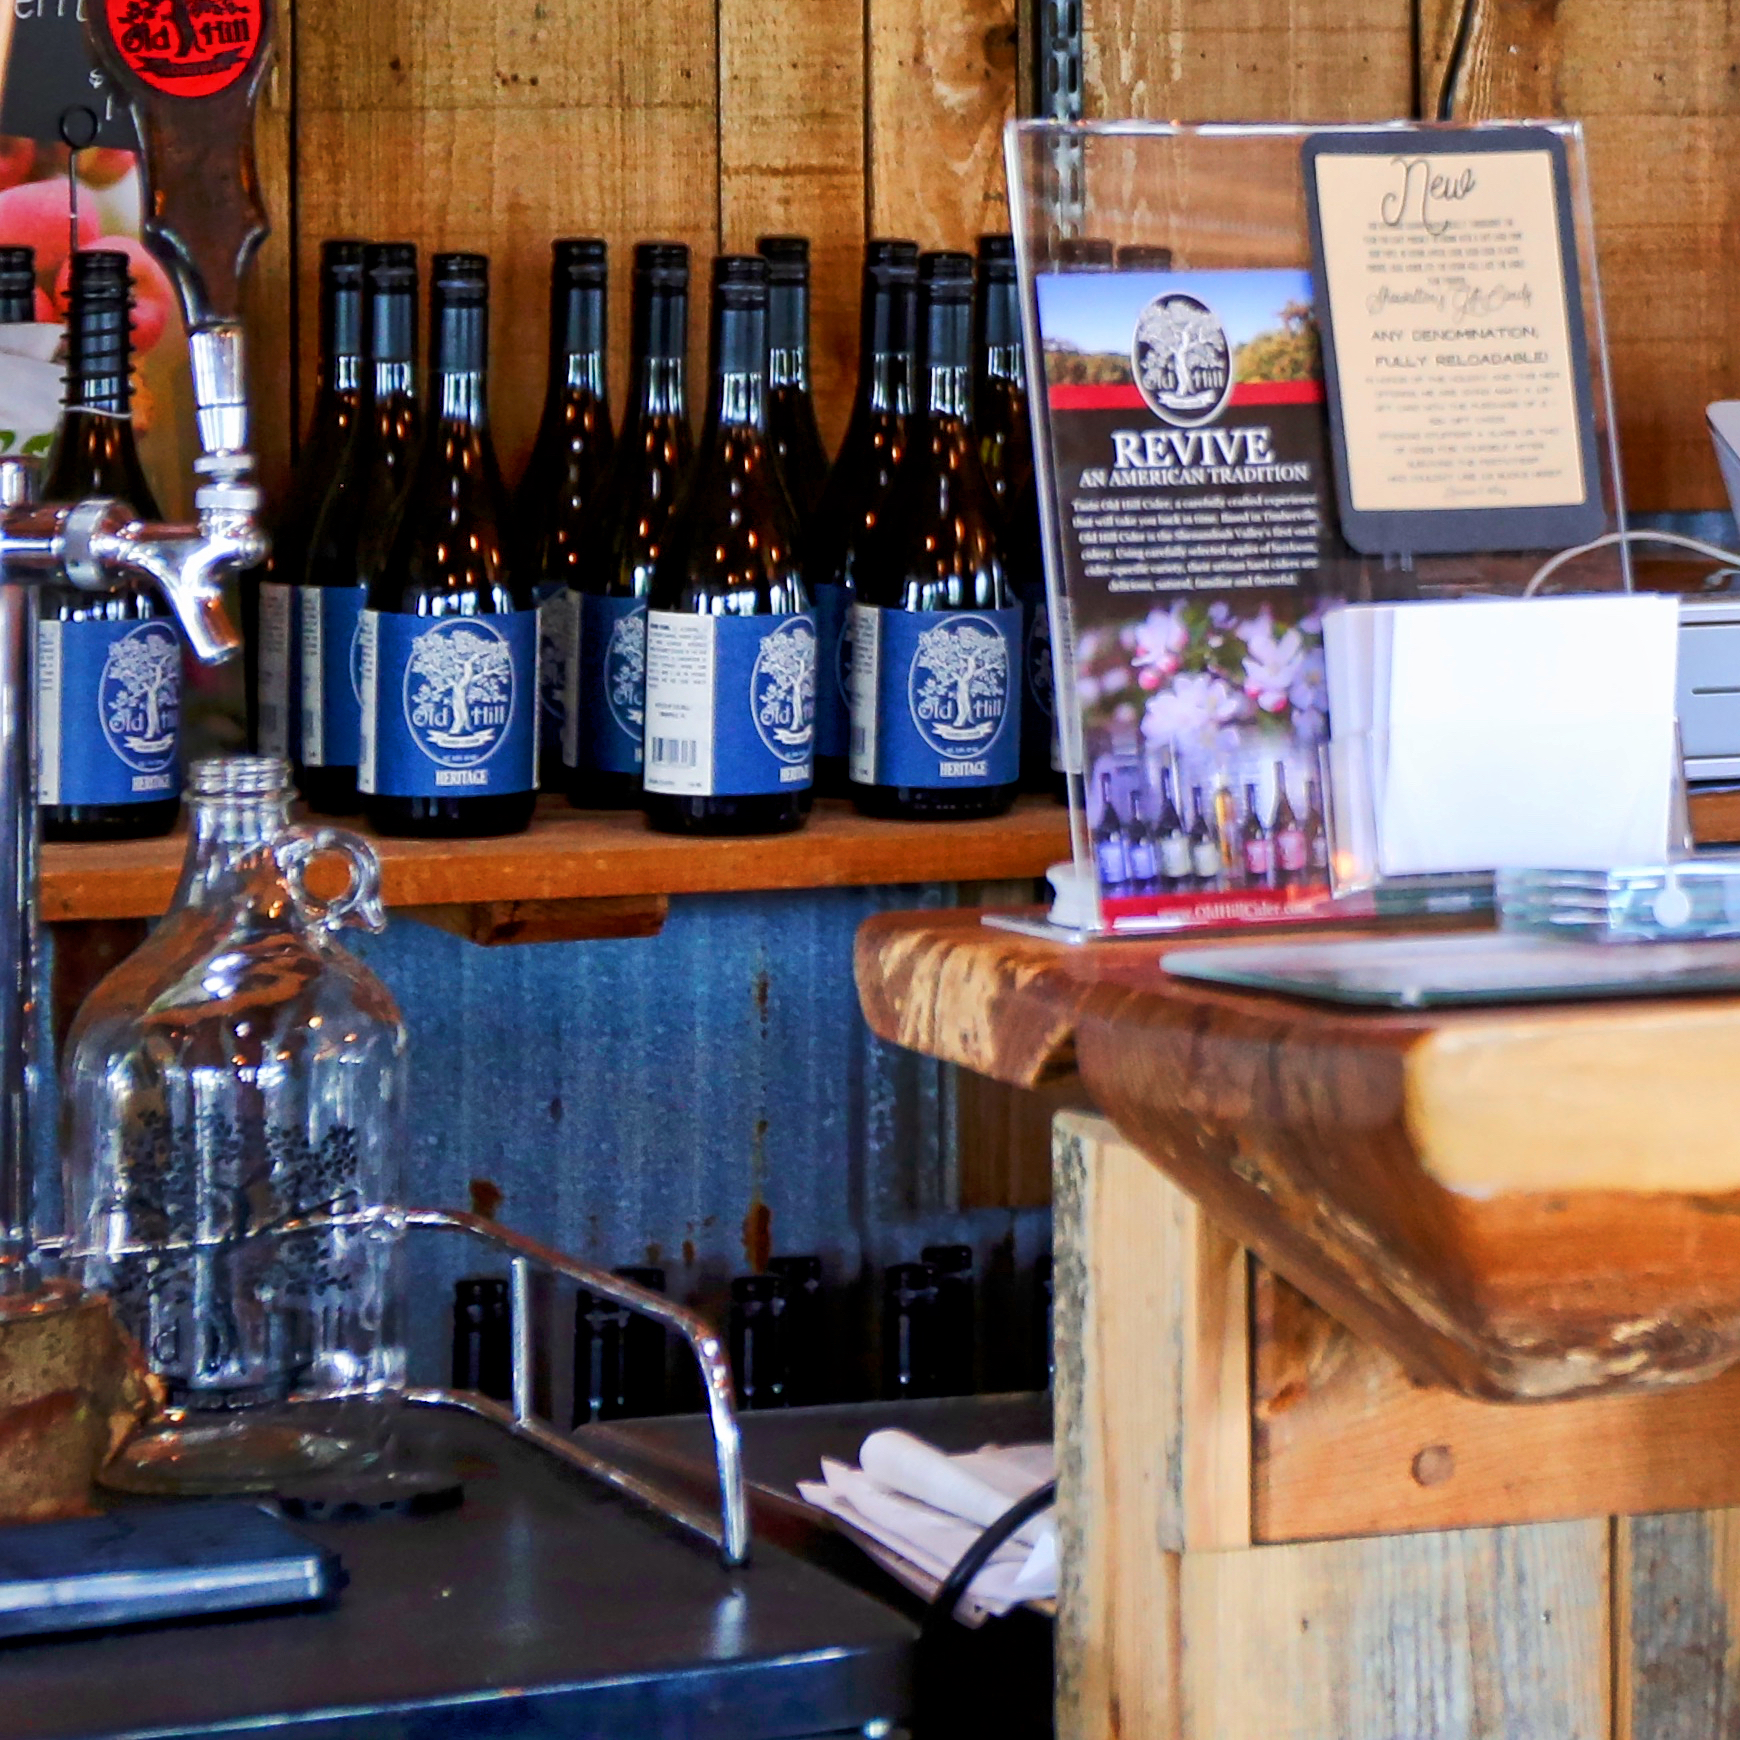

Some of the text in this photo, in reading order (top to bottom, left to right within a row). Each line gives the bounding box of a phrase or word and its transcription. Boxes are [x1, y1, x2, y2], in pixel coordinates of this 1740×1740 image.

[120, 18, 250, 53] Old Hill
[1381, 155, 1476, 236] New
[1371, 329, 1404, 343] ANY
[1375, 355, 1427, 369] FULLY
[1142, 368, 1177, 391] Old
[1110, 426, 1276, 468] REVIVE
[1078, 463, 1310, 489] AN AMERICAN TRADITION
[1101, 497, 1120, 510] Old
[1122, 496, 1141, 510] Hill
[1183, 494, 1226, 509] carefully
[1227, 493, 1262, 507] crafted
[1073, 515, 1092, 528] that
[1094, 514, 1113, 527] will
[1115, 513, 1137, 527] take
[1079, 530, 1097, 544] Old
[1100, 530, 1118, 543] Hill
[1119, 529, 1145, 543] Cider
[1145, 545, 1187, 560] carefully
[1235, 575, 1251, 588] and
[412, 705, 505, 727] Old Hill
[760, 707, 790, 726] Old
[917, 698, 1001, 720] Old Hill
[109, 711, 144, 733] Old
[435, 768, 488, 786] HERITAGE
[939, 760, 987, 777] HERITAGE
